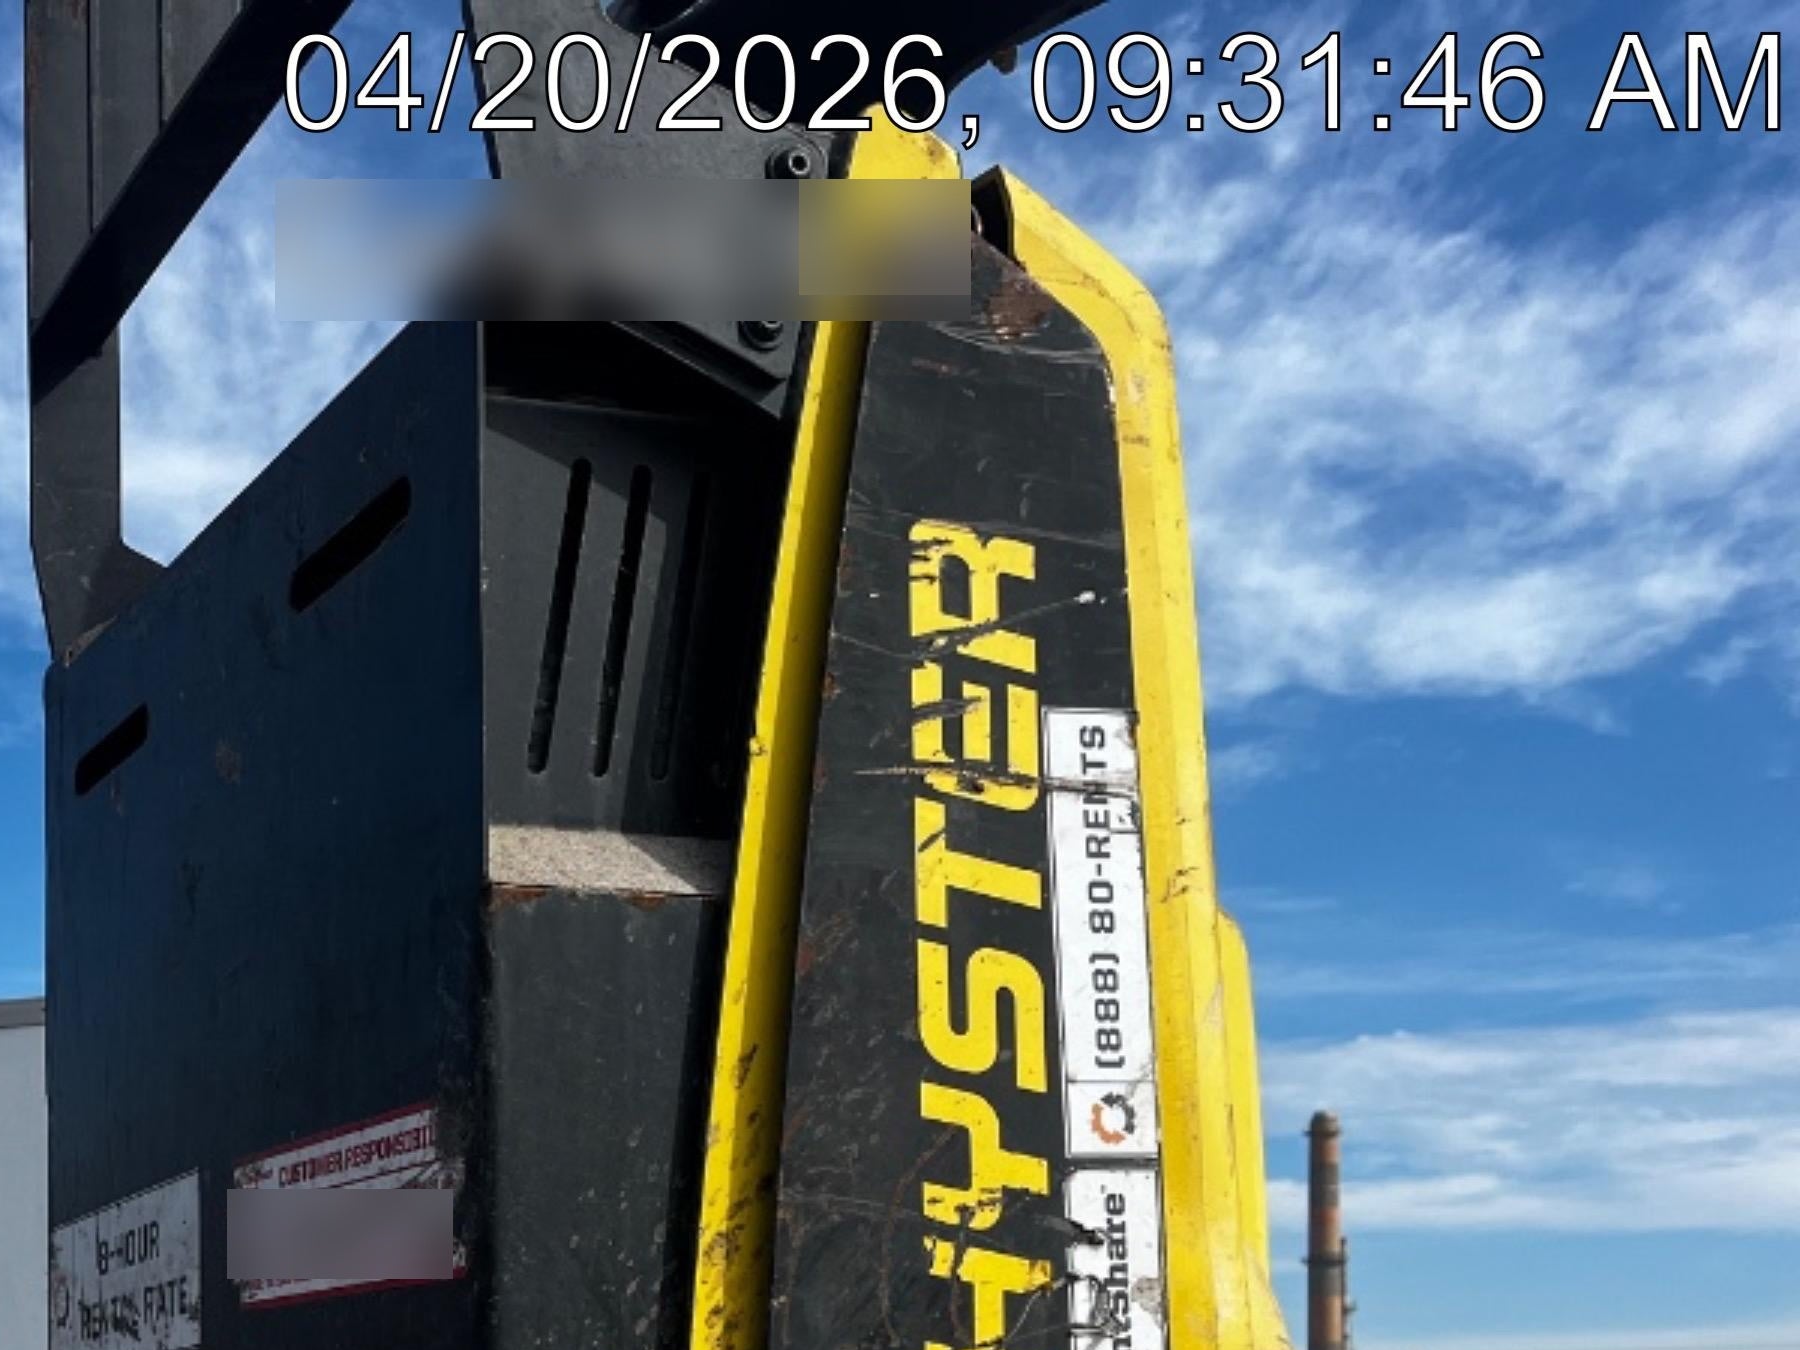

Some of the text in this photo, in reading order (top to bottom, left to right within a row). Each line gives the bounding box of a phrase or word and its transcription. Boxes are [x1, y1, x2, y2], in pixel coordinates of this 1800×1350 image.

[1079, 724, 1126, 1069] (888) 80-RENTS
[279, 1150, 343, 1188] CUSTOMER
[344, 1125, 436, 1171] RESPONSIBIL
